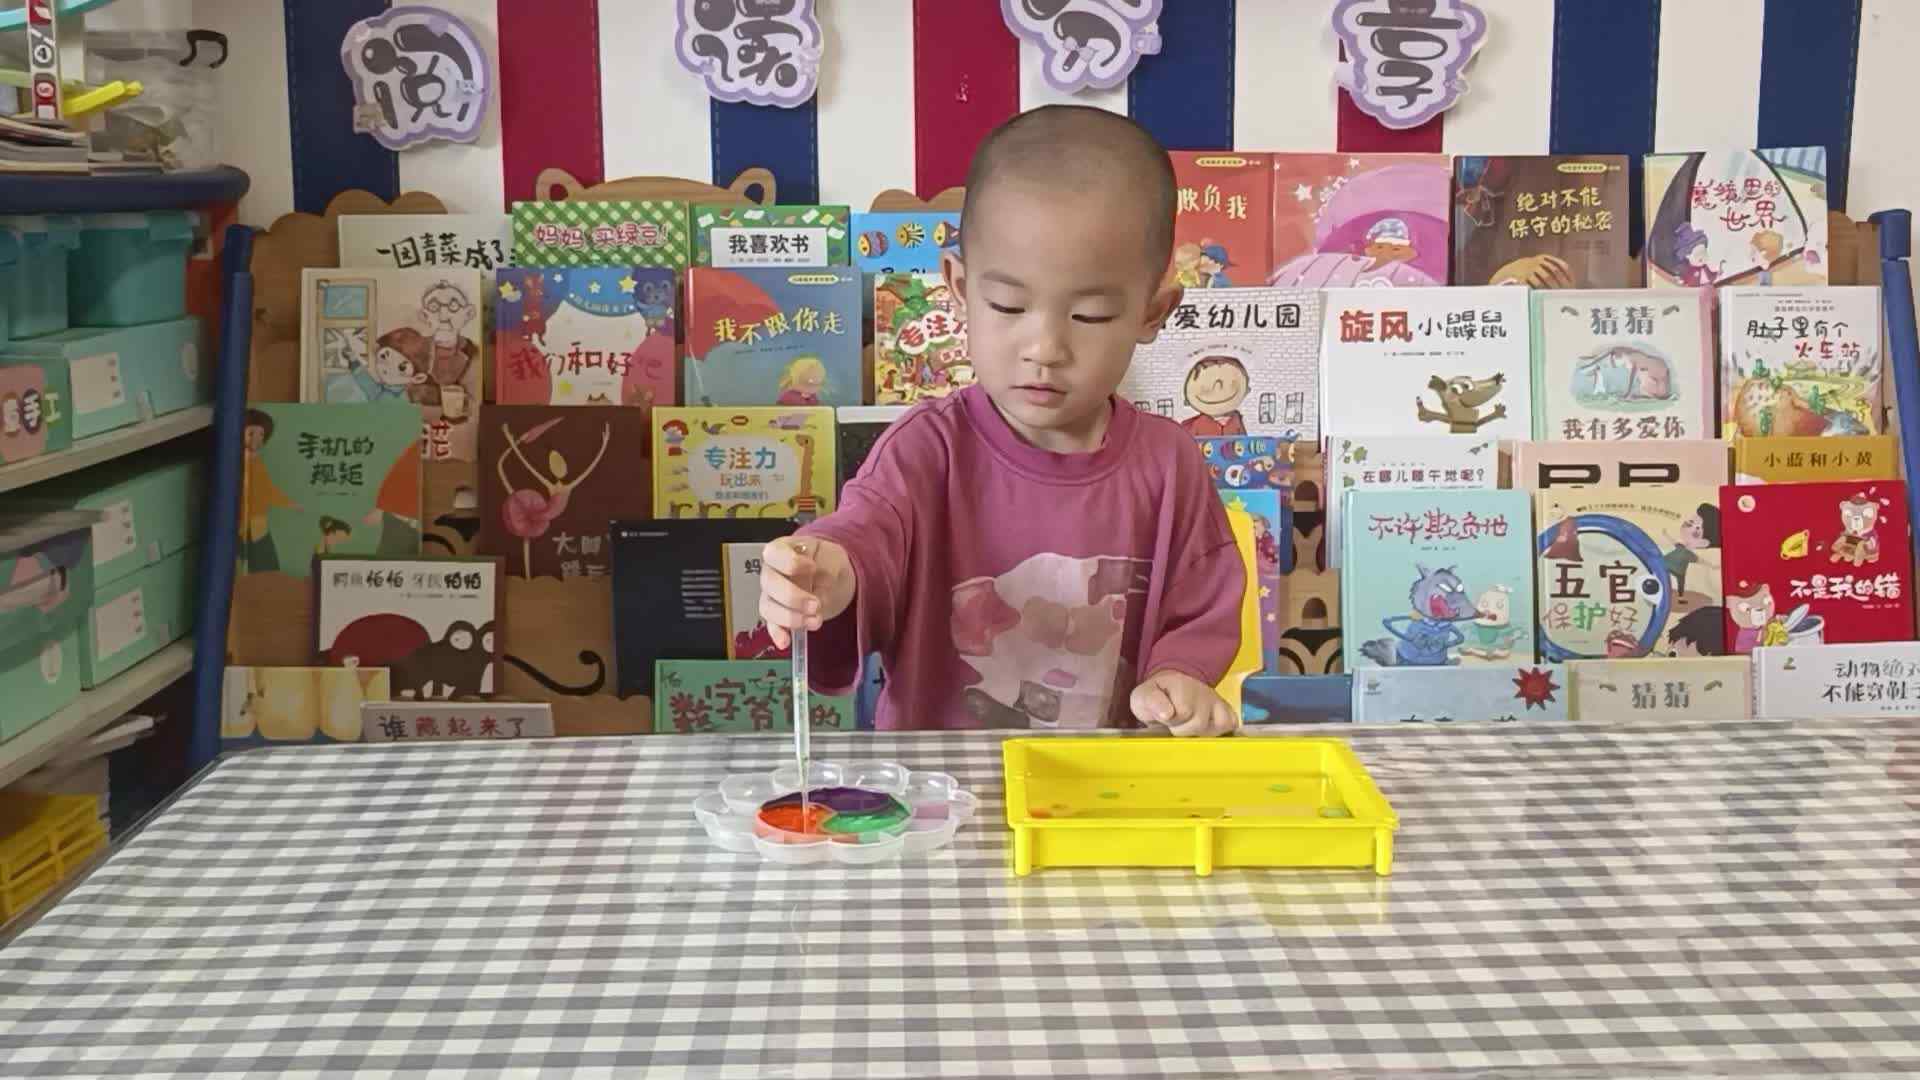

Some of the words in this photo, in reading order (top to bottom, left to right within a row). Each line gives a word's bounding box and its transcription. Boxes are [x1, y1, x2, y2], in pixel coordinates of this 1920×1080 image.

[1516, 185, 1602, 212] 绝对不能
[1509, 210, 1613, 239] 保守的秘密
[1720, 199, 1787, 232] 世界
[729, 234, 809, 254] 我喜欢书
[713, 307, 846, 345] 我不跟你走
[1161, 303, 1300, 329] 爱幼儿园
[1340, 310, 1507, 343] 旋风小鼹鼠
[1591, 306, 1653, 335] 猜猜
[1747, 316, 1849, 340] 肚子里有个
[1794, 340, 1860, 359] 火车站
[1562, 416, 1685, 440] 我有多爱你
[297, 432, 374, 458] 手机的
[704, 446, 776, 470] 专注力
[1763, 452, 1873, 467] 小蓝和小黄
[1362, 468, 1484, 483] 在哪儿睡午觉呢?
[1368, 507, 1508, 544] 不许欺负他
[1550, 560, 1638, 603] 五官
[1544, 602, 1638, 631] 保护好
[1632, 682, 1690, 709] 猜猜
[377, 715, 525, 738] 谁藏起来了
